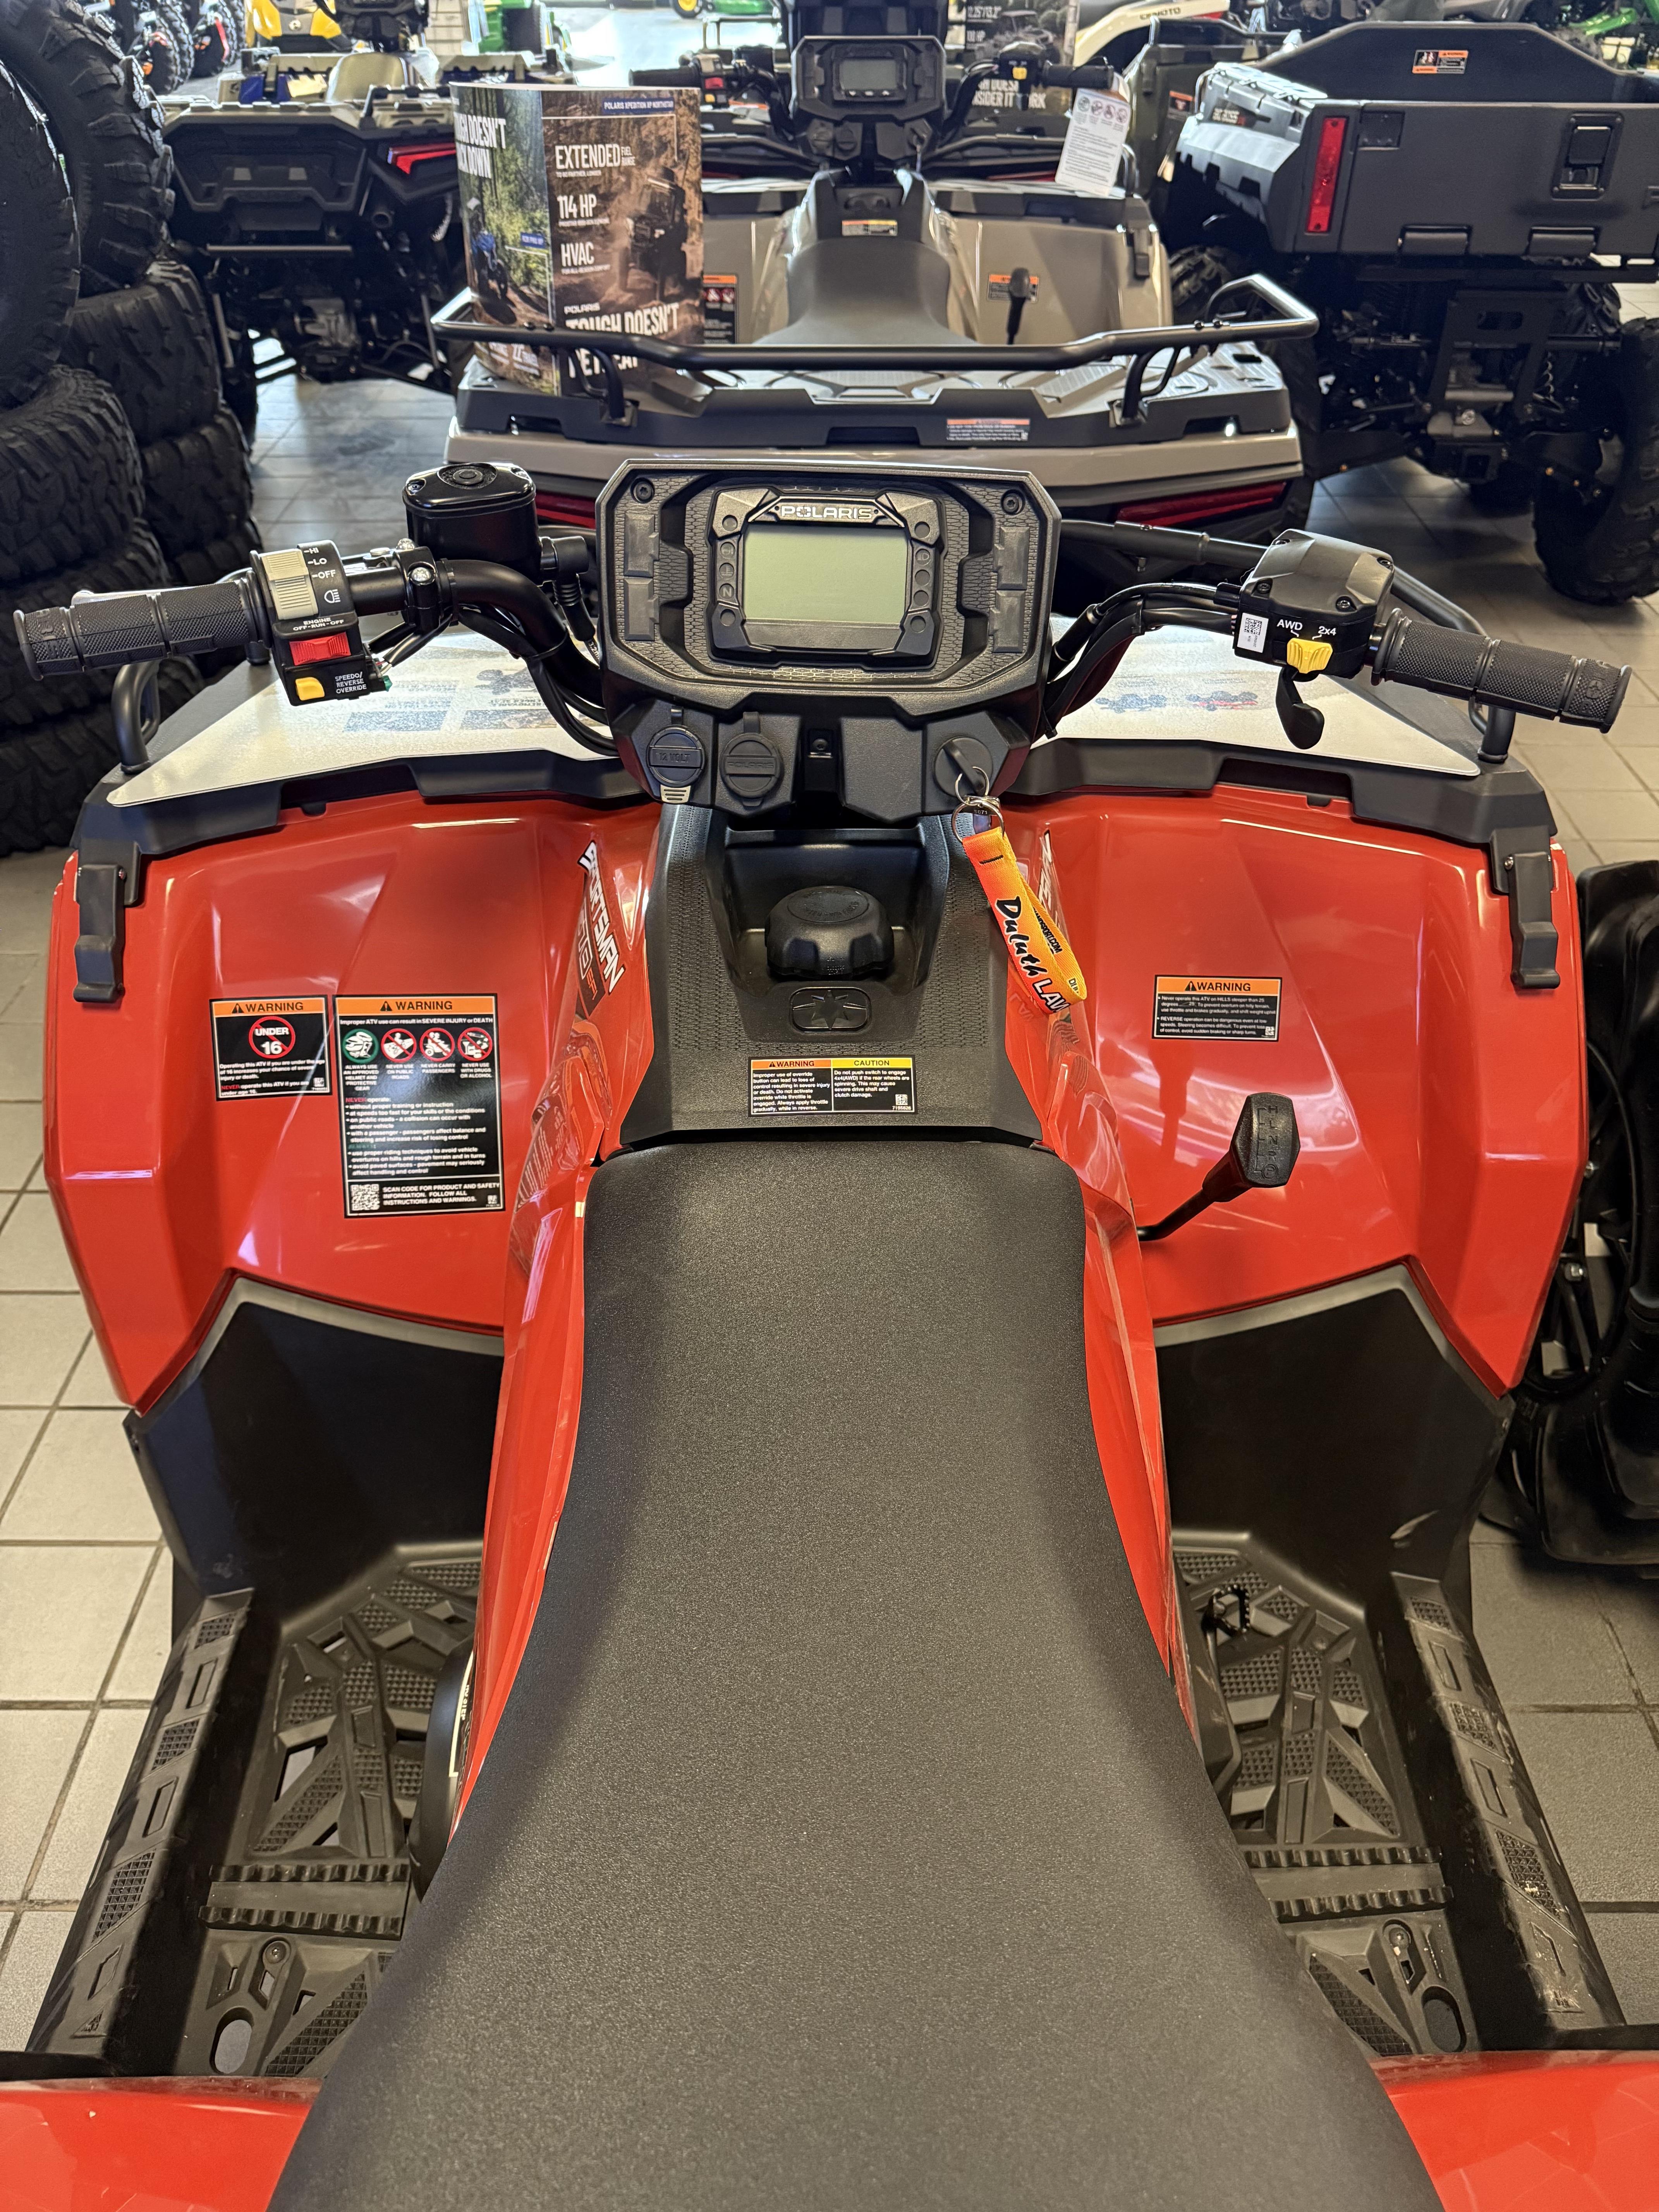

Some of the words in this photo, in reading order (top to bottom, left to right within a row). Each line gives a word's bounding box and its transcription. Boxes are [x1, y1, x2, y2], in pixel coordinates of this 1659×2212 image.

[467, 115, 506, 149] DOESN'T
[555, 144, 620, 169] EXTENDED
[557, 196, 577, 219] 114
[580, 194, 597, 217] HP
[561, 242, 594, 266] HVAC
[564, 302, 600, 314] POLARIS
[624, 302, 679, 336] DOESN'T
[781, 506, 872, 519] POLARIS
[318, 570, 336, 579] OFF
[1277, 619, 1302, 630] AWD
[1318, 626, 1336, 635] 2x4
[335, 672, 362, 682] SPEEDO/
[336, 678, 364, 688] REVERSE
[336, 684, 367, 694] OVERRIDE
[659, 752, 668, 762] 12
[669, 753, 690, 763] VOLT
[577, 840, 626, 995] SPORTSMAN
[995, 896, 1048, 978] Duluth
[1197, 982, 1251, 992] WARNING
[245, 1002, 304, 1012] WARNING
[395, 1001, 453, 1010] WARNING
[254, 1027, 290, 1036] UNDER
[261, 1041, 283, 1054] 16
